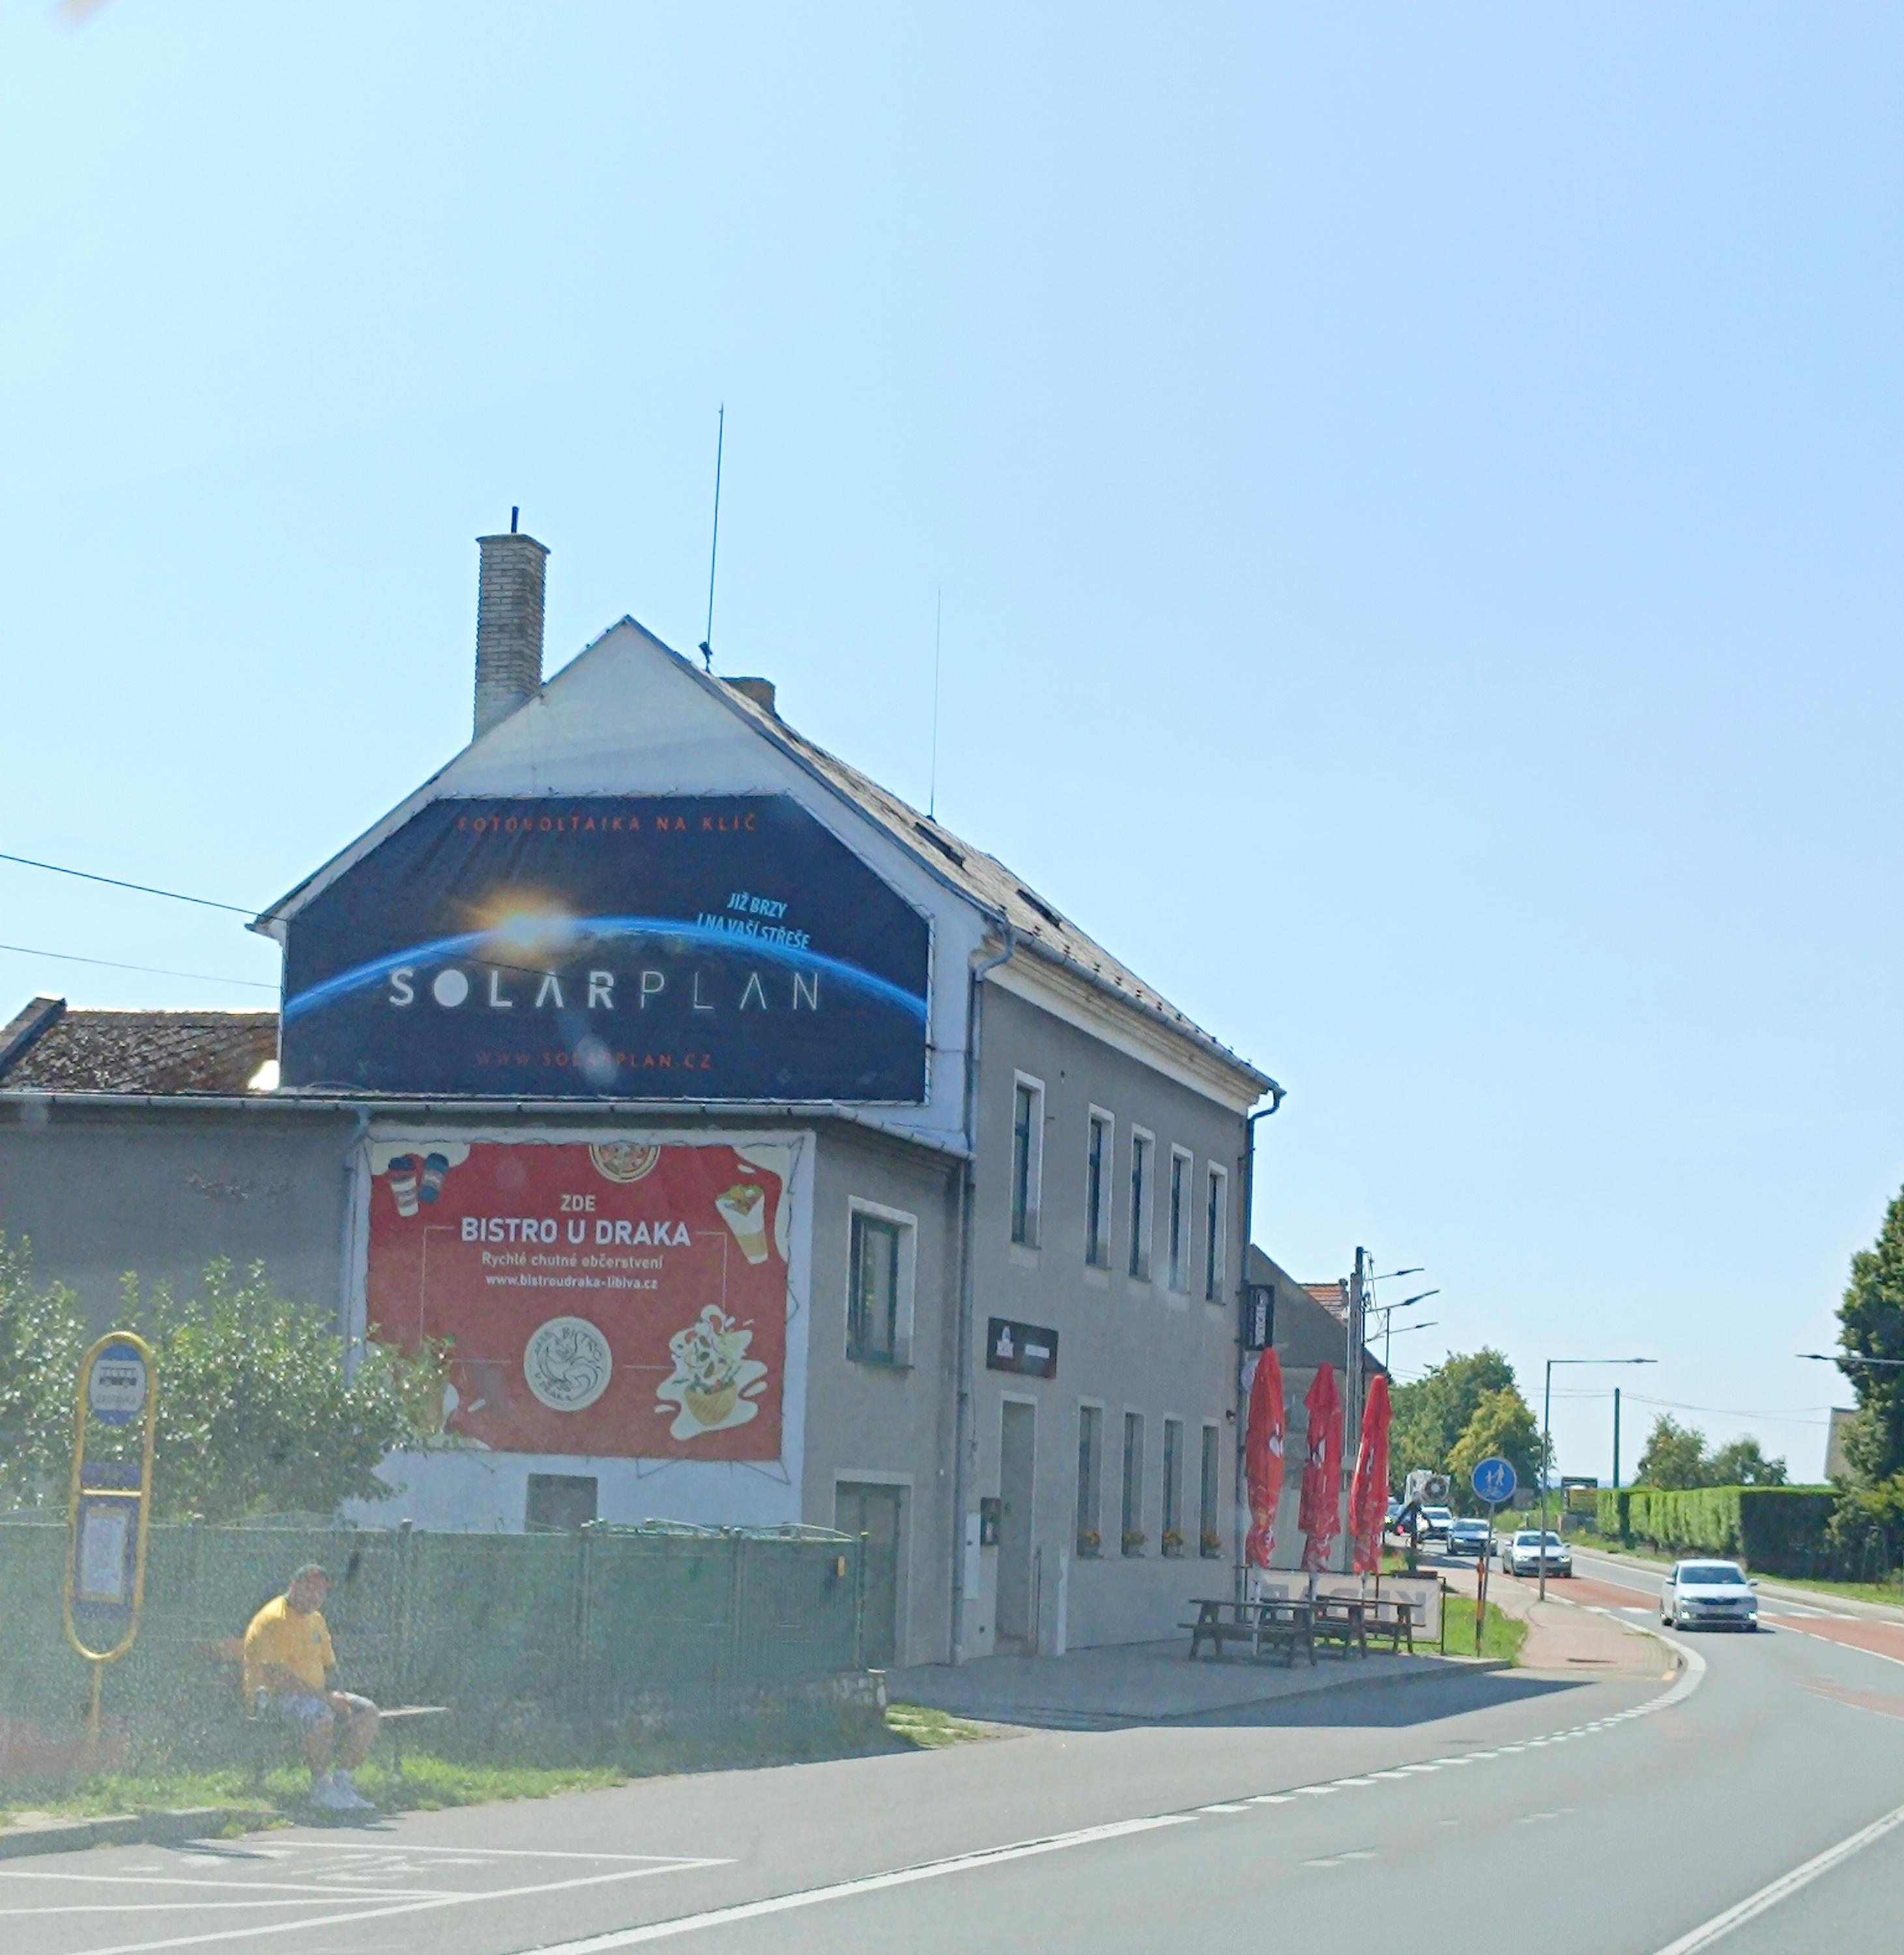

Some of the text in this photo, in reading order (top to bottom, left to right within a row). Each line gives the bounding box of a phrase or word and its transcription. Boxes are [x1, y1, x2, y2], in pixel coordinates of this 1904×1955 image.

[457, 816, 641, 832] FOTOVOLTAIKA
[656, 817, 688, 832] NA
[727, 891, 788, 919] JIŽ BRZY
[697, 912, 811, 950] I NA VAŠÍ STŘEŠE
[389, 968, 819, 1011] SOLARPLAN
[560, 1194, 597, 1212] ZDE
[461, 1216, 692, 1247] BISTRO U DRAKA
[531, 1252, 578, 1268] chutné
[581, 1252, 664, 1270] občerstvení
